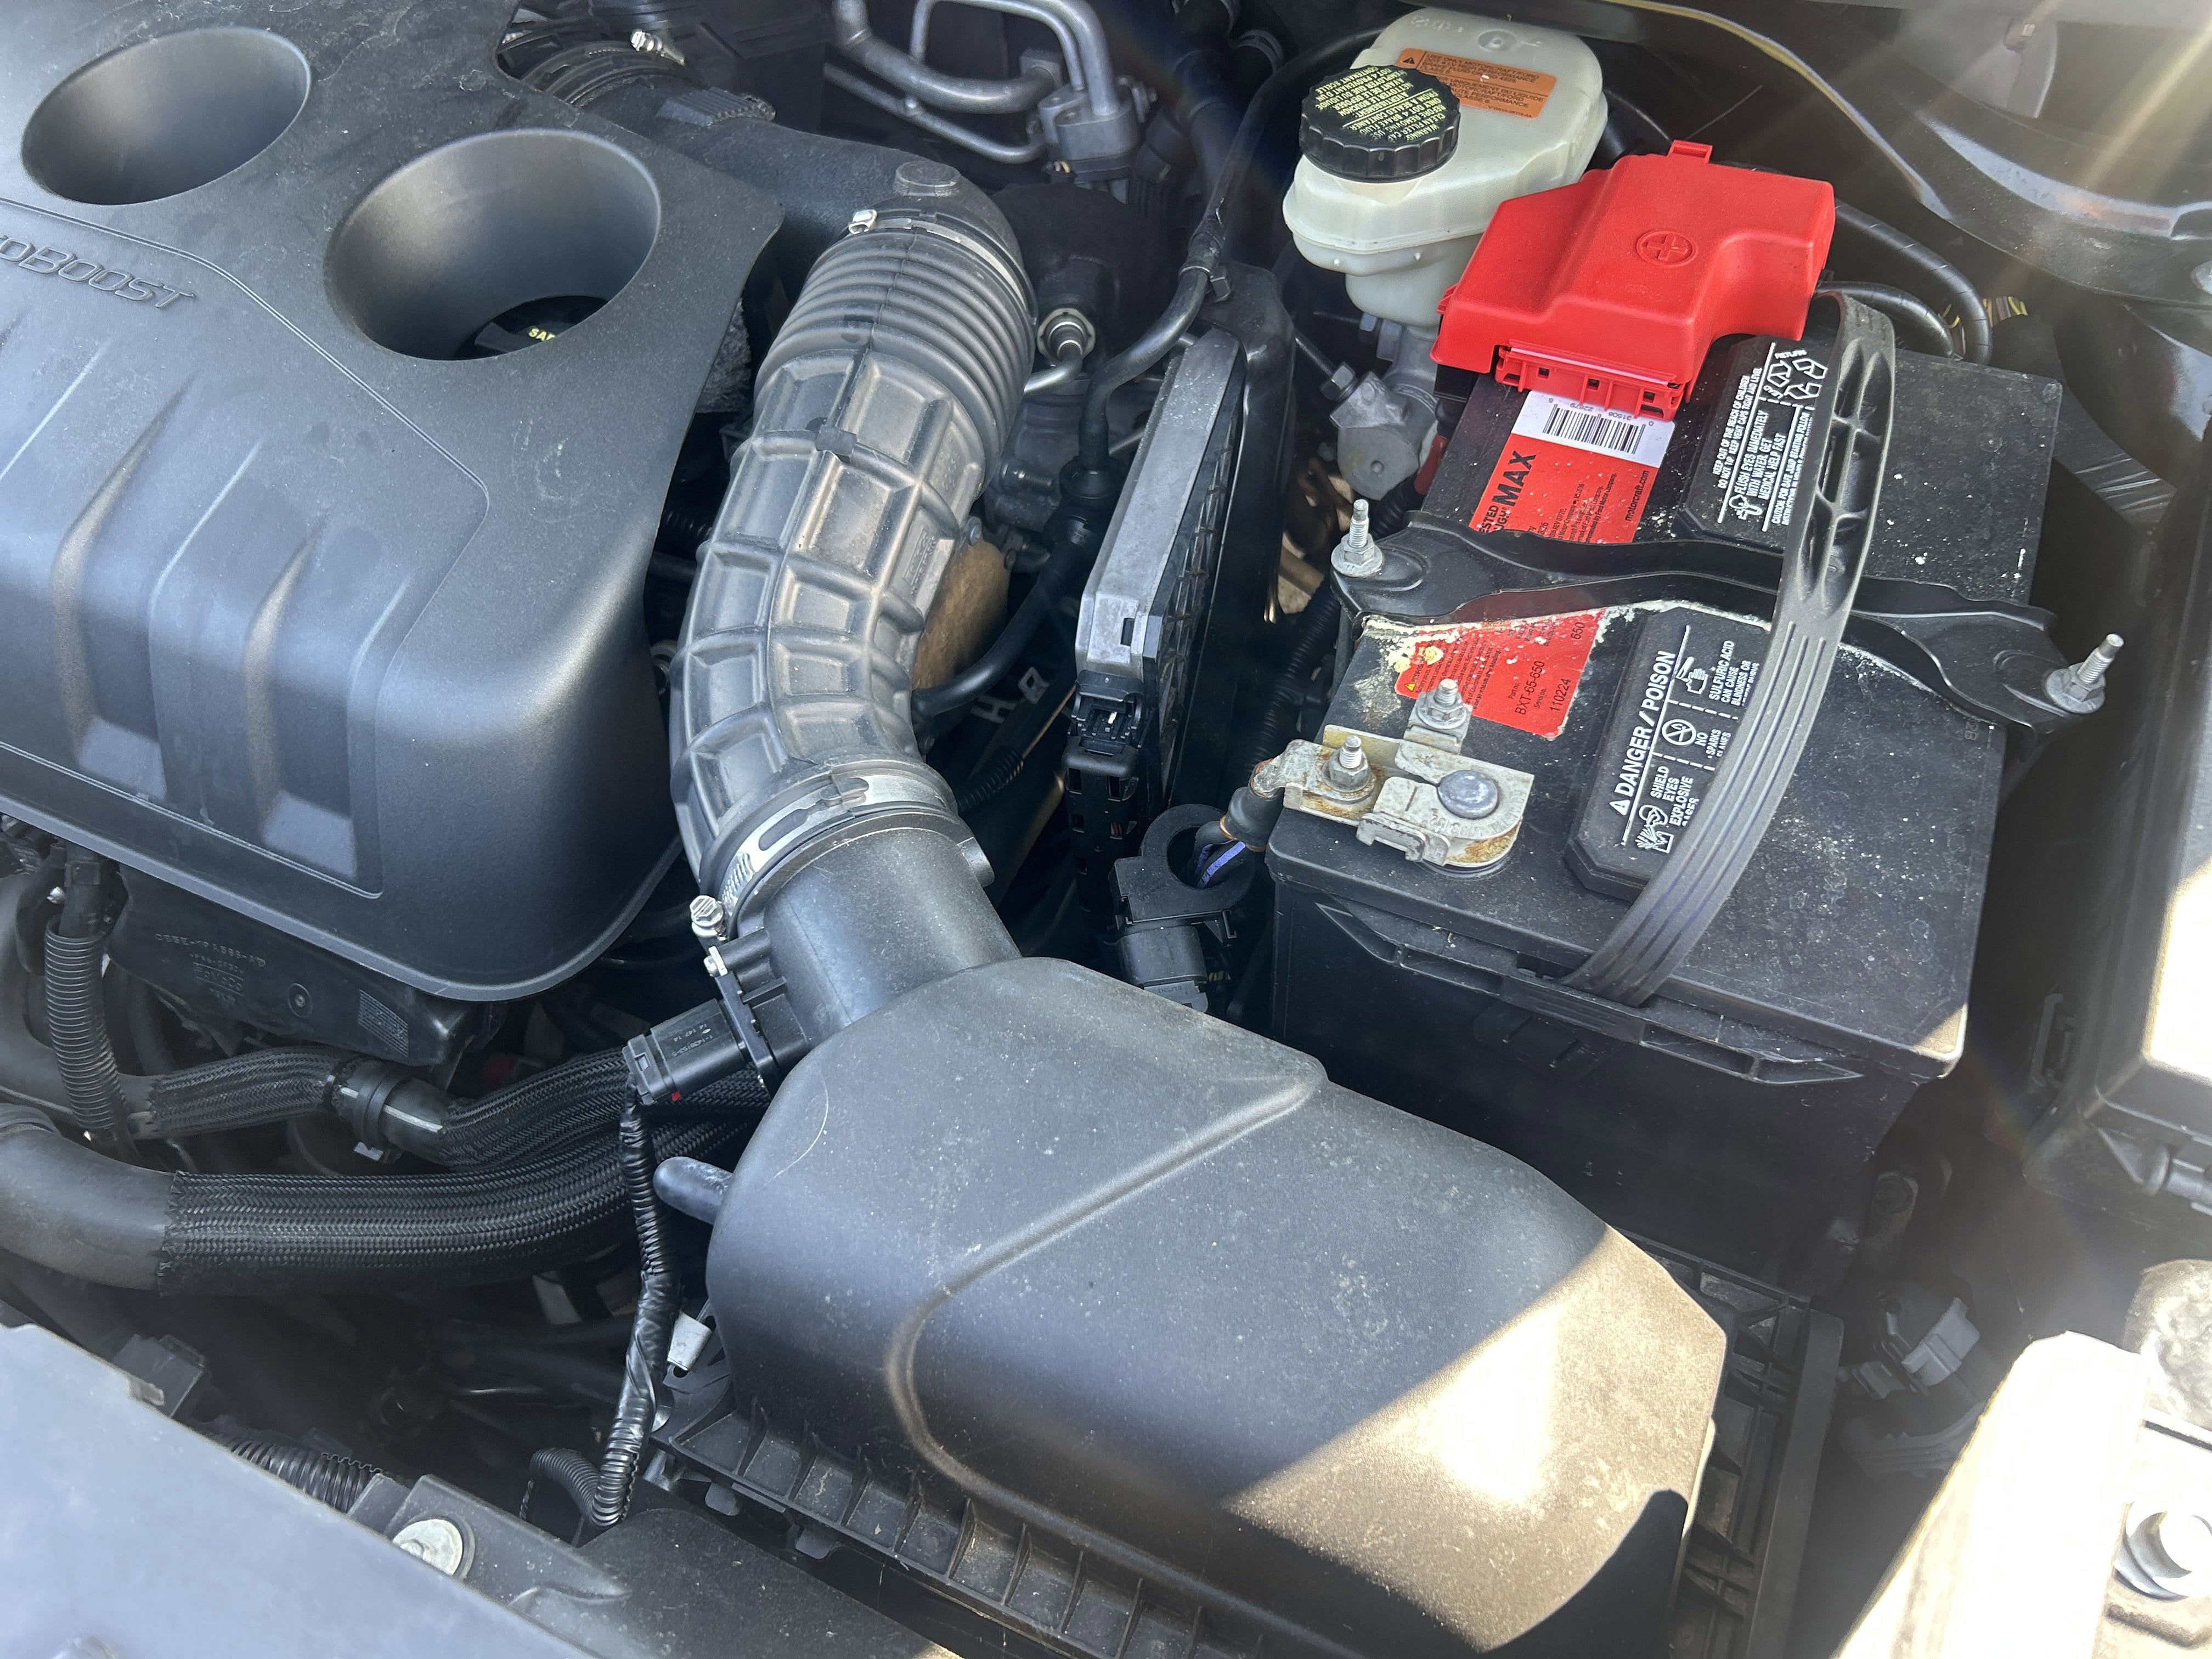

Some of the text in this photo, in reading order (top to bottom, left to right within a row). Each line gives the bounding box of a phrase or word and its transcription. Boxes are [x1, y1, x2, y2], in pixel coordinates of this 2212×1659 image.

[1340, 64, 1379, 84] CONTENANT
[1376, 68, 1392, 77] DOT
[1477, 67, 1537, 83] PERFORMANCE
[1330, 75, 1373, 95] PROVENANT
[1350, 85, 1367, 95] QUE
[1369, 87, 1383, 95] DE
[1374, 82, 1414, 100] NETTOYER
[1380, 77, 1404, 91] AVANT
[1315, 95, 1344, 110] LIQUIDE
[1341, 91, 1354, 99] DU
[1361, 91, 1374, 99] LE
[1416, 91, 1439, 102] FROM
[1469, 91, 1530, 108] PERFORMANCE
[1338, 100, 1372, 116] BOUCHON
[1383, 101, 1413, 115] SEALED
[1408, 104, 1425, 114] DOT
[1423, 98, 1442, 108] ONLY
[1418, 104, 1446, 118] BEFORE
[1378, 114, 1403, 127] BRAKE
[1421, 112, 1446, 126] CLEAN
[1359, 123, 1381, 134] FLUID
[1369, 129, 1386, 140] USE
[1400, 121, 1425, 134] FILLER
[0, 233, 196, 309] OBOOST
[1774, 349, 1808, 360] RETURN
[1746, 382, 1757, 394] AND
[1741, 394, 1753, 410] TIGHT
[1712, 375, 1751, 475] KEEP OUT OF THE REACH OF CHILDREN
[1737, 410, 1749, 425] CAPS
[1796, 412, 1810, 433] FOLLOW
[1732, 425, 1744, 439] VENT
[1728, 439, 1739, 455] KEEP
[1734, 410, 1769, 495] FLUSH EYES IMMEDIATELY
[1789, 433, 1804, 459] STARTING
[1720, 466, 1731, 479] NOT
[1746, 478, 1761, 496] WITH
[1759, 438, 1773, 453] GET
[1758, 433, 1786, 500] MEDICAL HELP FAST
[1785, 458, 1797, 474] JUMP
[1492, 450, 1537, 507] MAX
[1717, 479, 1728, 489] DO
[1781, 473, 1793, 488] SAFE
[1599, 492, 1609, 506] Motor
[1624, 470, 1649, 522] motorcraft.com
[1778, 487, 1789, 500] FOR
[1595, 505, 1604, 516] Ford
[1477, 505, 1499, 535] ESTED
[1549, 622, 1585, 711] 110224 650
[1708, 640, 1735, 700] SULFURIC ACID
[1514, 661, 1545, 715] BXT-65-650
[1720, 666, 1739, 703] CAN CAUSE
[1727, 671, 1748, 707] BLINDNESS
[1740, 660, 1751, 671] OR
[1508, 687, 1518, 699] Part
[1533, 695, 1544, 709] Serial
[1614, 726, 1653, 797] DANGER
[1641, 651, 1676, 712] POISON
[1694, 732, 1708, 747] NO
[1650, 766, 1669, 798] SHIELD
[1662, 777, 1680, 802] EYES
[1664, 776, 1694, 826] EXPLOSIVE
